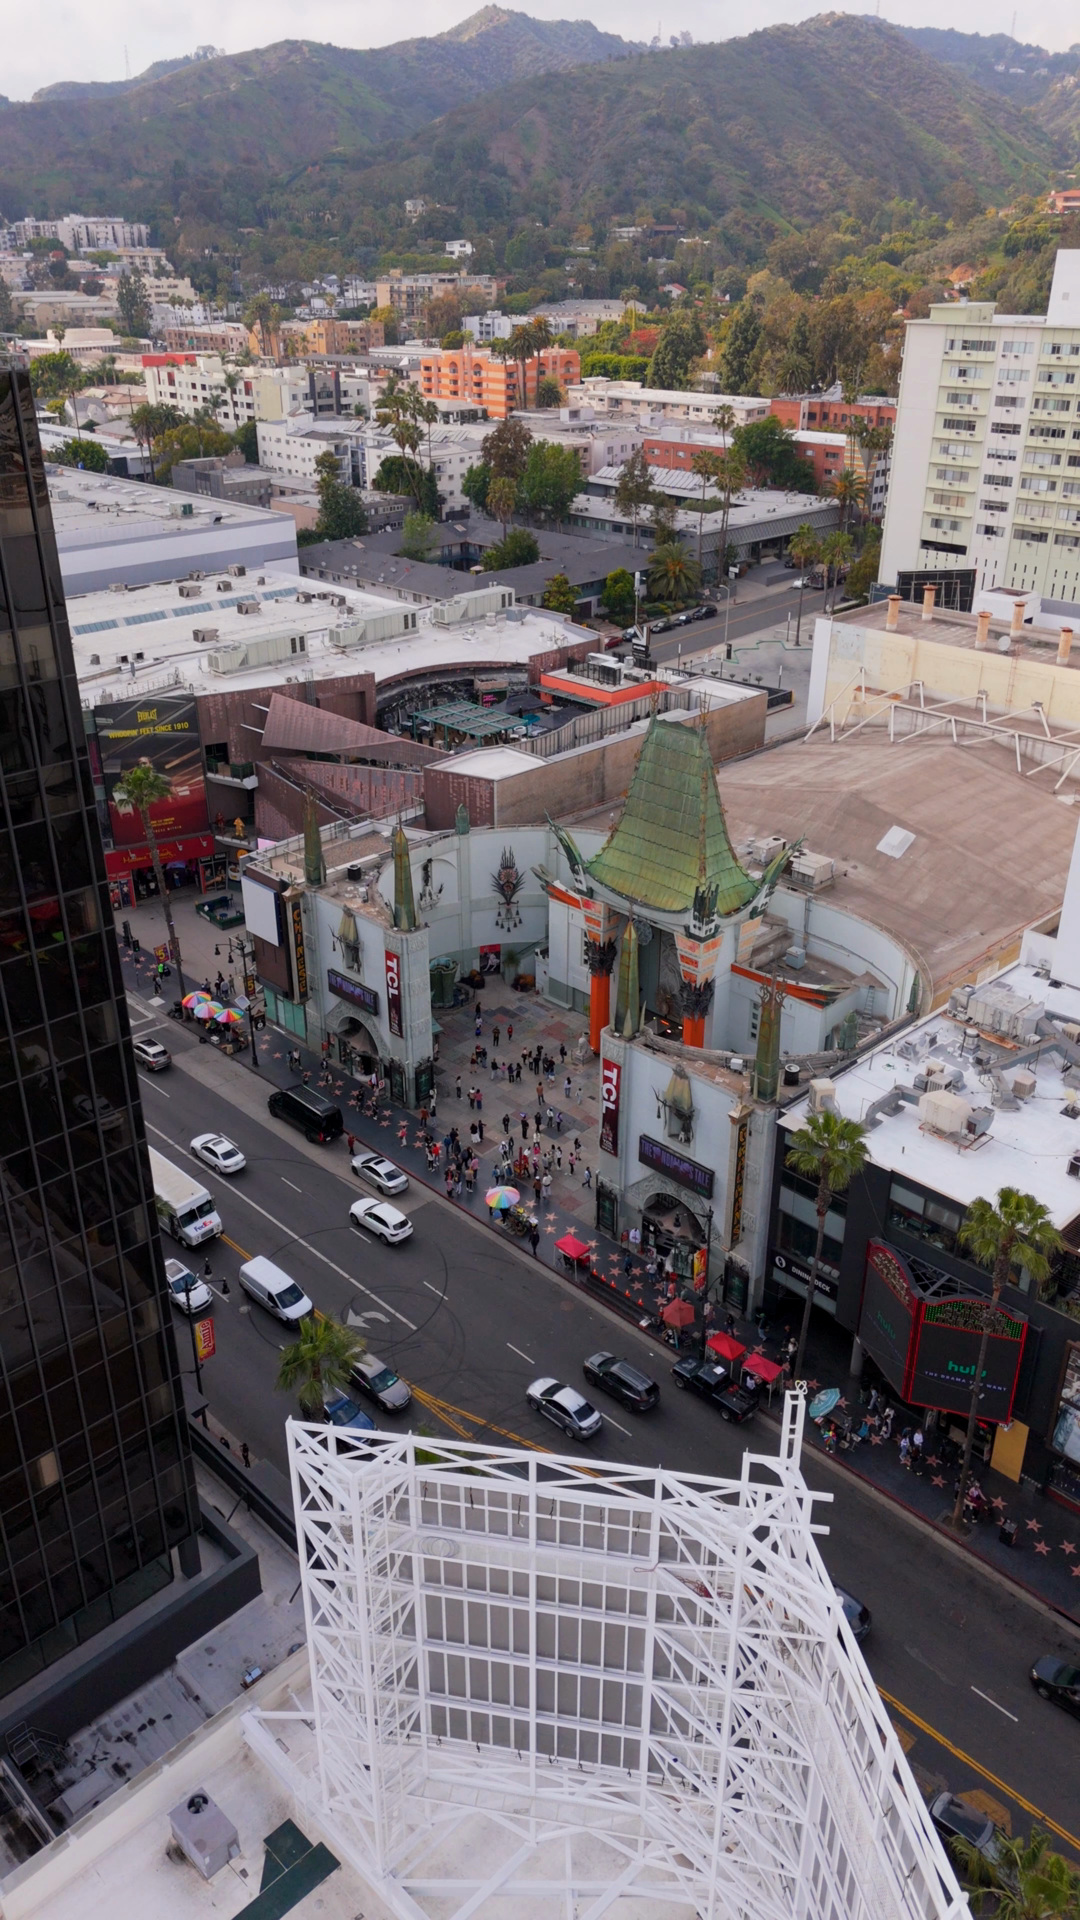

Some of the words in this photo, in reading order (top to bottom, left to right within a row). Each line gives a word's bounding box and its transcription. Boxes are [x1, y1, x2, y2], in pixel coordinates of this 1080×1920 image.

[140, 726, 154, 735] FEET
[155, 724, 172, 733] SINCE
[173, 721, 189, 731] 1910
[293, 908, 307, 993] CHINESE
[386, 958, 399, 999] TCL
[602, 1067, 618, 1114] TCL
[194, 1220, 213, 1232] FedEx
[814, 1279, 831, 1293] DECK
[943, 1307, 1006, 1325] CHINE
[947, 1360, 987, 1378] hulu
[940, 1374, 967, 1384] DRAMA
[986, 1384, 1007, 1392] WANT
